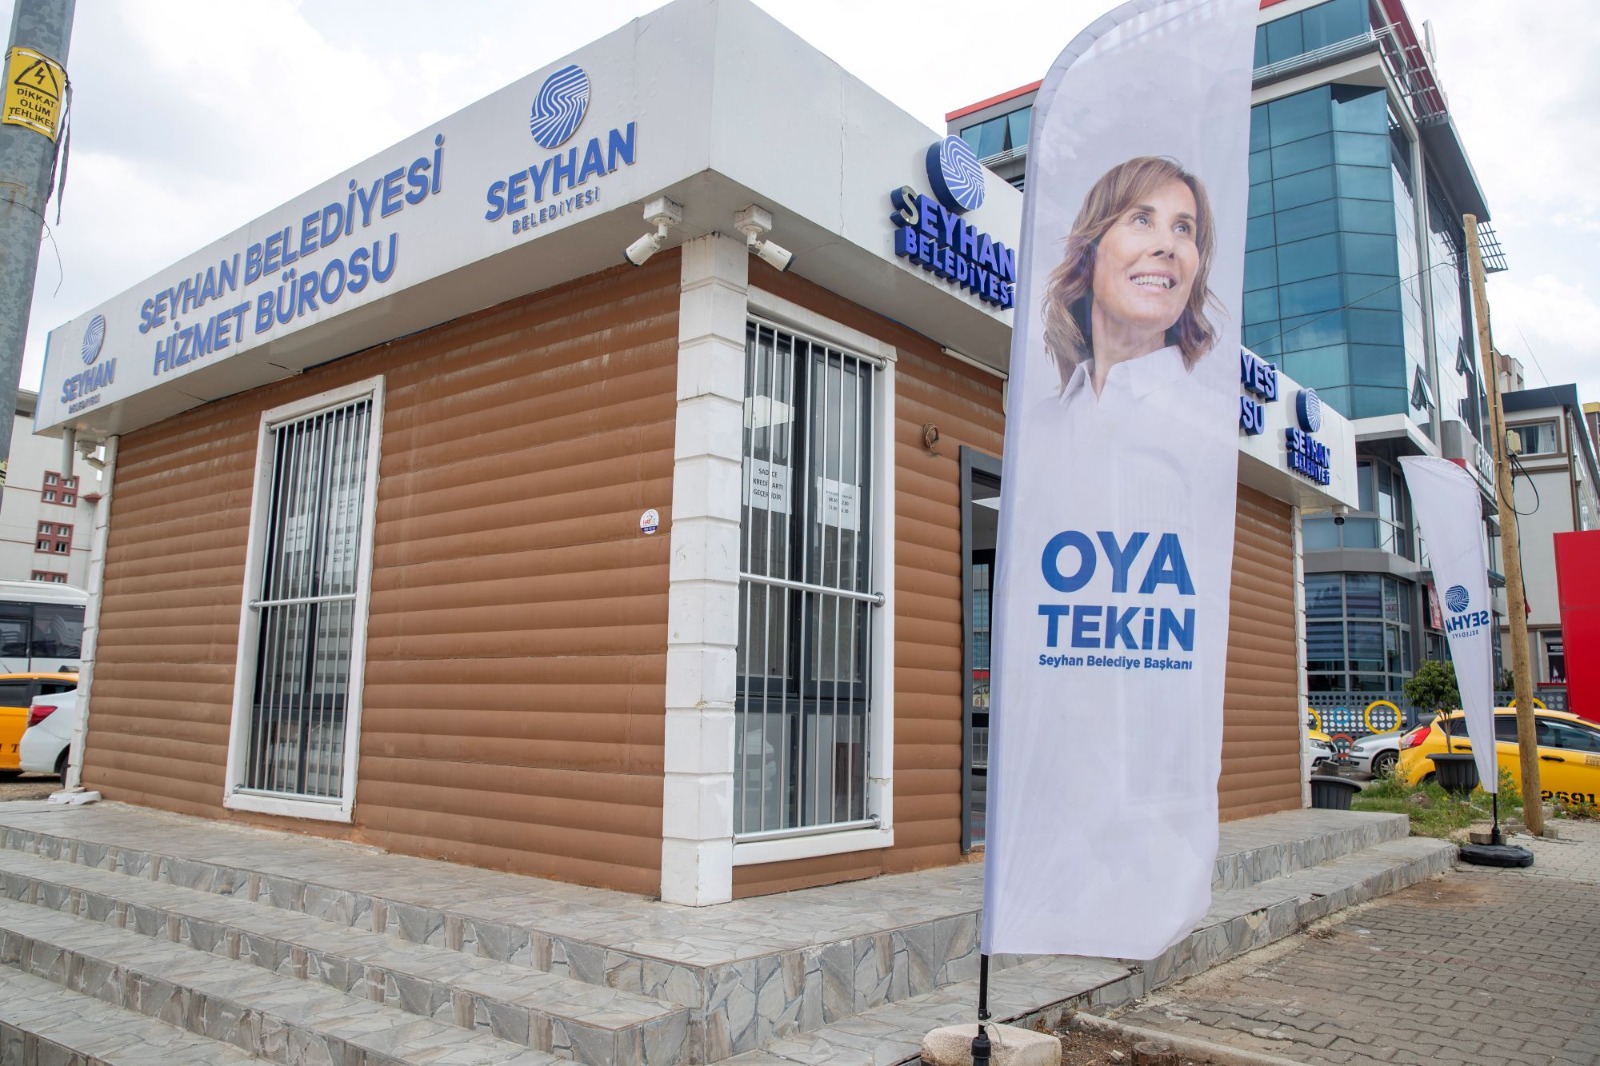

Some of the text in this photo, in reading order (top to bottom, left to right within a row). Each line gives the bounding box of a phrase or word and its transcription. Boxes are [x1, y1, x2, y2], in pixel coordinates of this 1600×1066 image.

[17, 88, 55, 108] DİKKAT
[20, 97, 50, 117] ÖLÜM
[485, 121, 637, 222] SEYHAN
[139, 133, 444, 334] SEYHAN BELEDİYESİ
[512, 187, 600, 235] BELEDİYESİ
[894, 185, 1016, 284] SEYHAN
[153, 232, 399, 376] HİZMET BÜROSU
[61, 358, 117, 403] SEYHAN
[1286, 427, 1331, 468] SEYHAN
[758, 467, 778, 478] SADCE
[1041, 530, 1196, 595] OYA
[1038, 654, 1193, 671] Seyhan Belediye Başkanı
